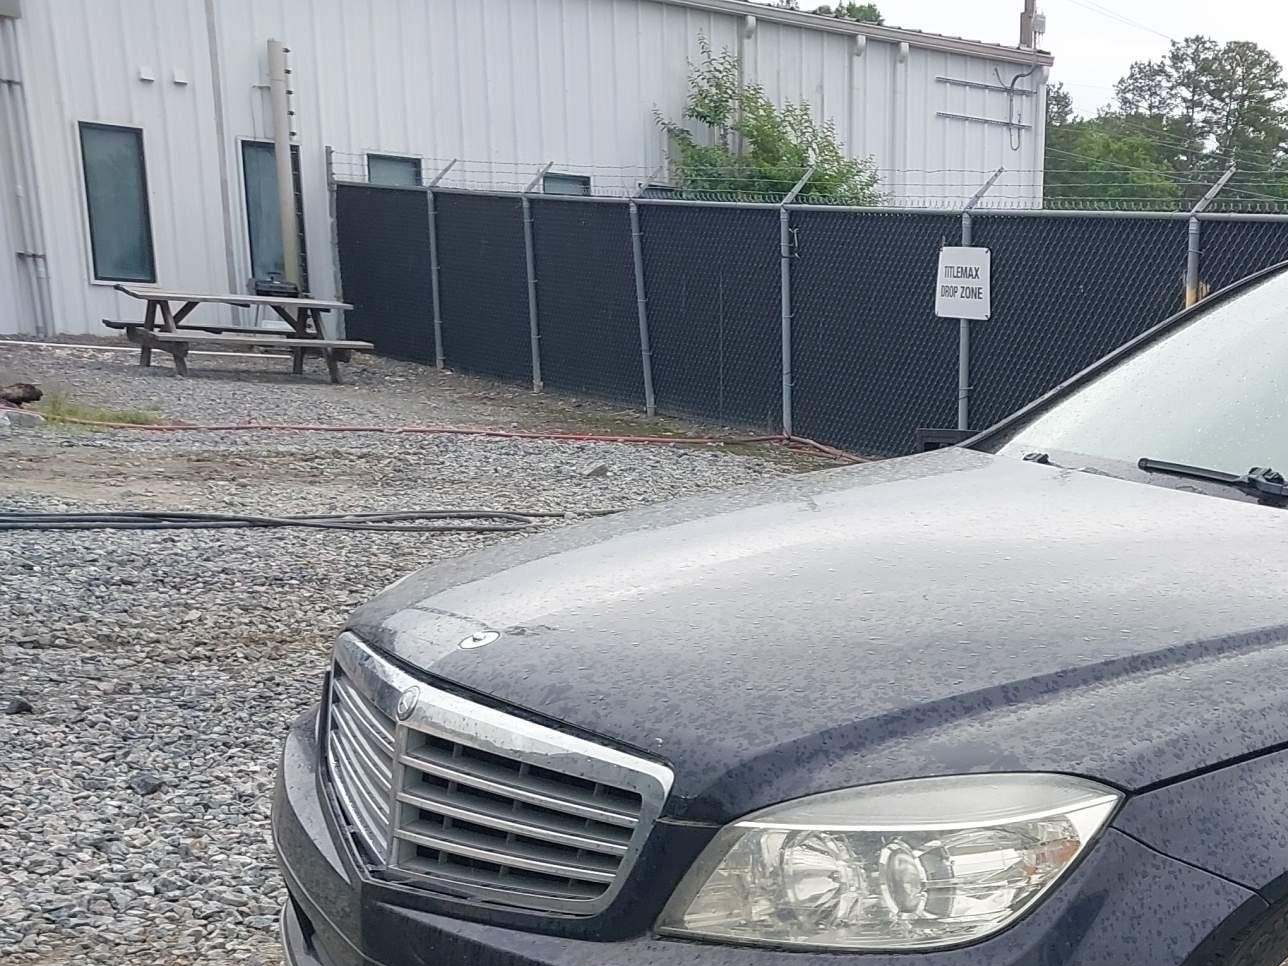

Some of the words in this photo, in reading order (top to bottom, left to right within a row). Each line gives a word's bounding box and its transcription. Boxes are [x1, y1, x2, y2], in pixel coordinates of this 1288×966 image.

[944, 266, 980, 279] TITLEMAX
[941, 285, 958, 298] DROP
[960, 286, 983, 299] ZONE
